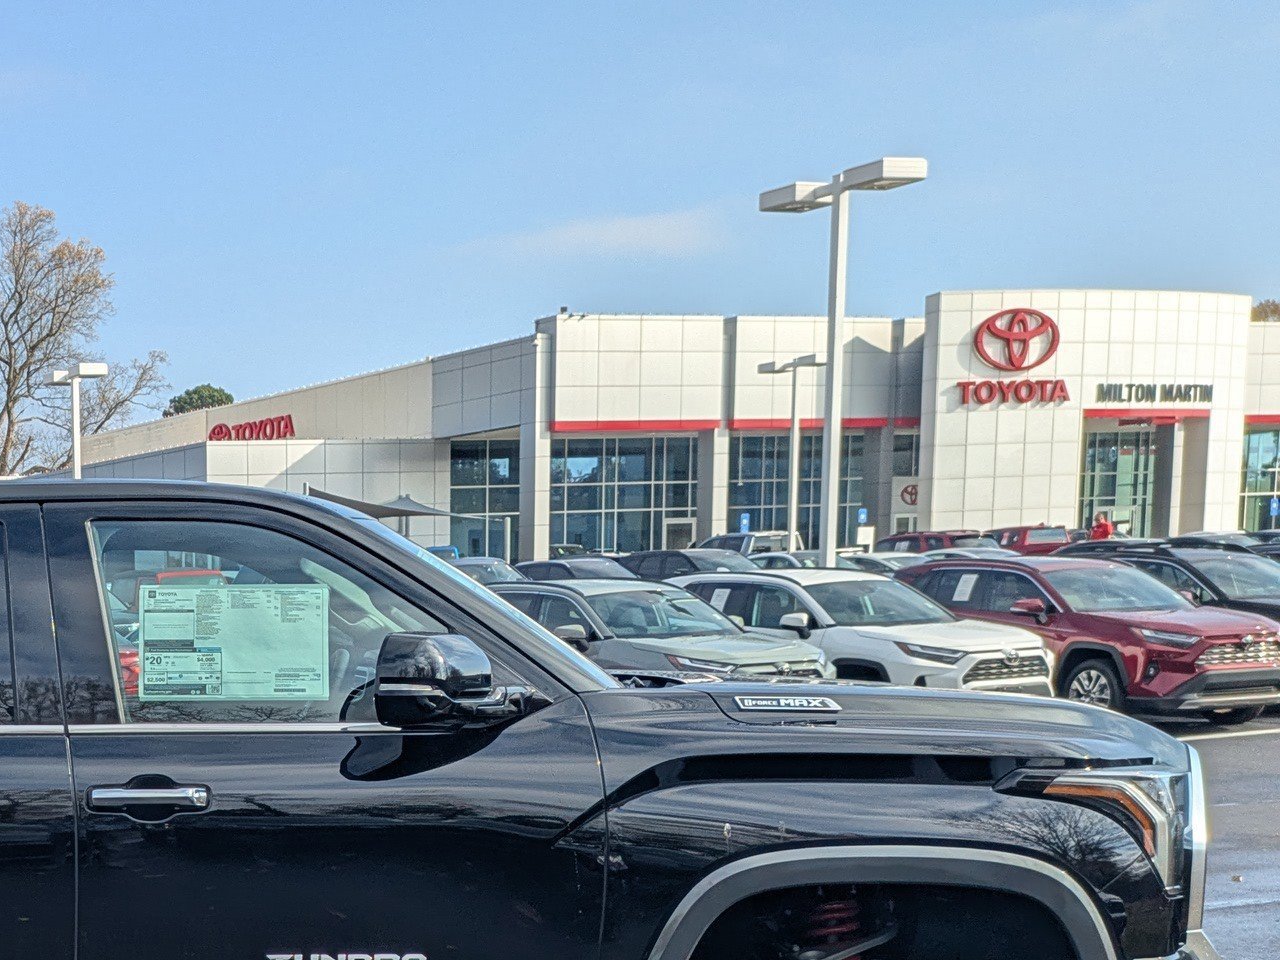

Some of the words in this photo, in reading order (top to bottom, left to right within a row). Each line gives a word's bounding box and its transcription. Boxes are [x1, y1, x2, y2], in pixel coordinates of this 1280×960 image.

[956, 379, 1069, 405] TOYOTA
[1095, 383, 1156, 404] MILTON
[1159, 383, 1214, 404] MARTIN
[231, 413, 296, 441] TOYOTA
[149, 656, 162, 665] 20
[780, 698, 823, 707] MAX
